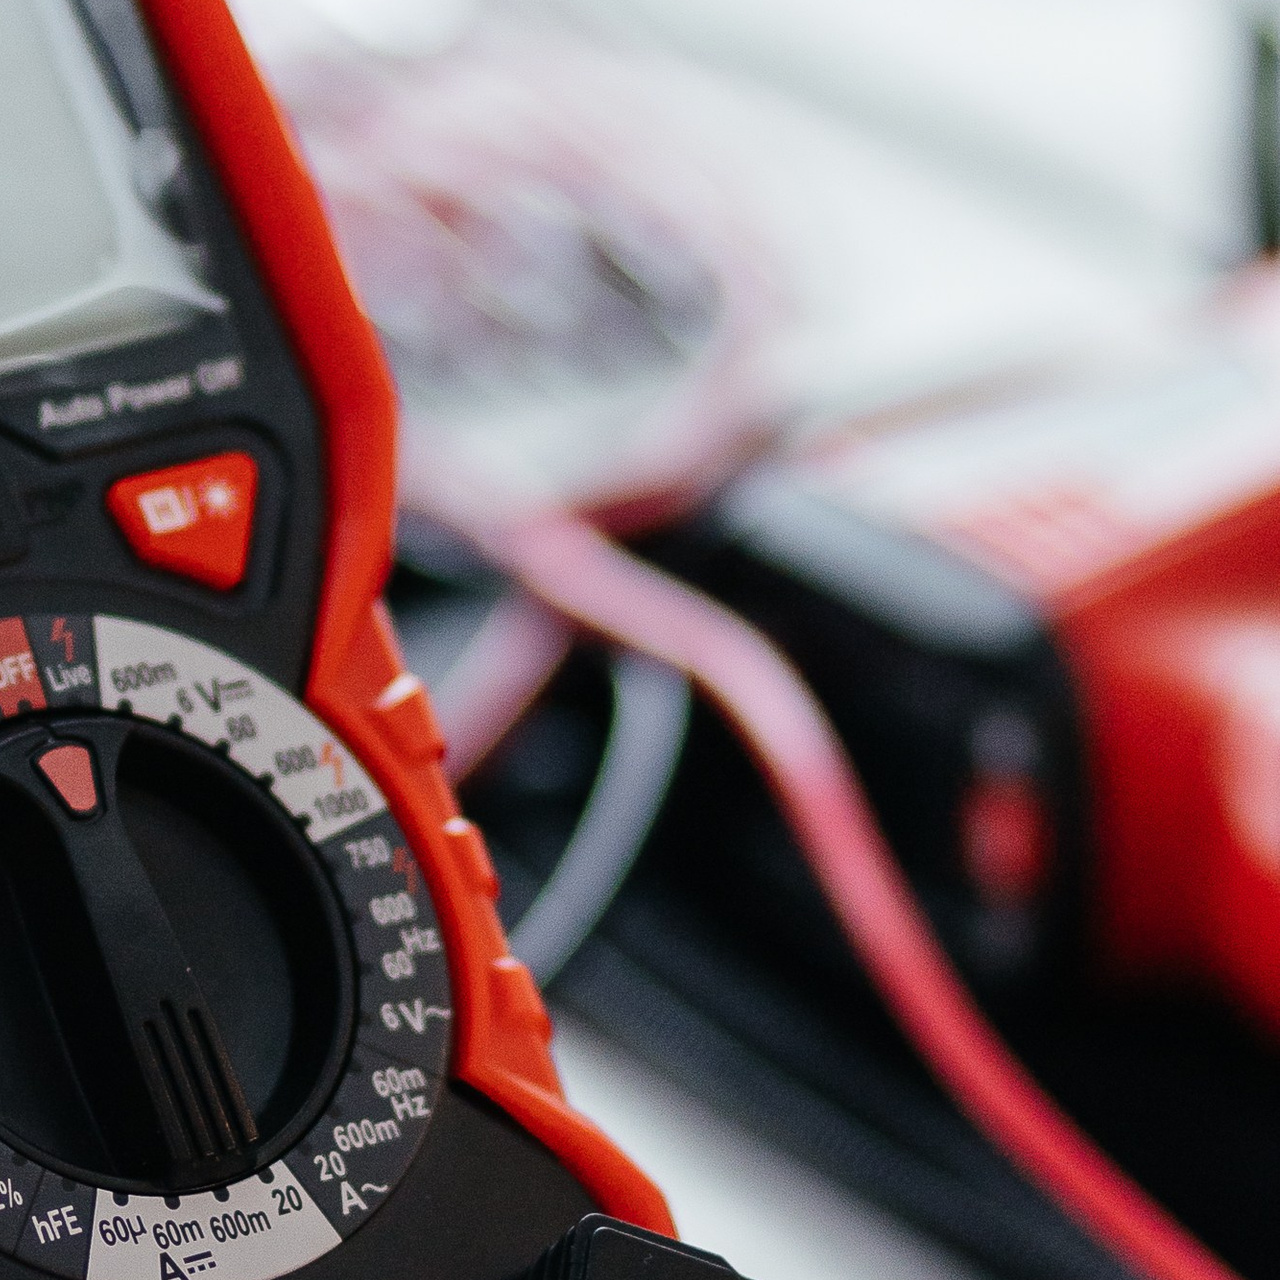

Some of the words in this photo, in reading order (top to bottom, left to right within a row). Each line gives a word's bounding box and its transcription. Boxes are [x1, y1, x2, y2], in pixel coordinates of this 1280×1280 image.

[39, 395, 104, 429] Auto
[106, 375, 191, 412] Power
[46, 664, 92, 693] Live
[111, 662, 177, 693] 600m
[345, 835, 391, 869] 750
[369, 892, 416, 925] 600
[400, 927, 440, 953] Hz
[382, 950, 414, 980] 60
[380, 1002, 399, 1031] 6
[372, 1066, 426, 1098] 60m
[390, 1093, 431, 1121] Hz
[333, 1119, 399, 1152] 600m
[314, 1151, 347, 1181] 20
[32, 1205, 83, 1244] hFE
[152, 1218, 205, 1249] 60m
[210, 1210, 271, 1243] 600m
[271, 1185, 303, 1216] 20
